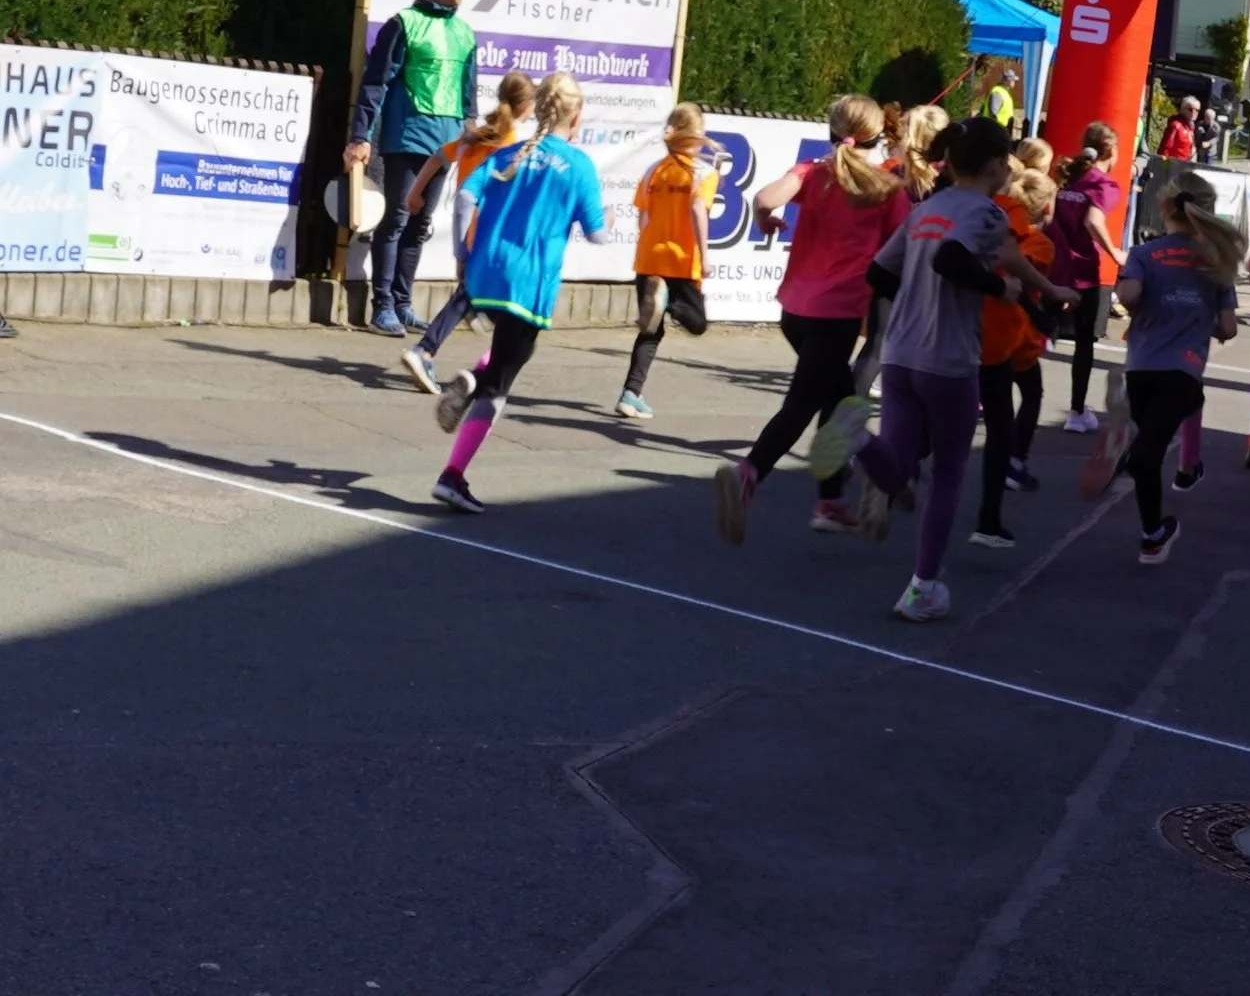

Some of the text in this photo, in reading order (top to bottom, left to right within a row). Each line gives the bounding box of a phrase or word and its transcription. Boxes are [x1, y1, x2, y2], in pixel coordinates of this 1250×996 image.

[511, 49, 548, 72] zum
[554, 44, 650, 78] Handwerk
[6, 61, 97, 98] HAUS
[109, 69, 301, 114] Baugenossenschaft
[2, 106, 94, 152] NER
[193, 110, 298, 143] Grimma eG
[160, 172, 289, 198] Hoch-, Tief- und Straßenbau
[753, 265, 783, 281] UND
